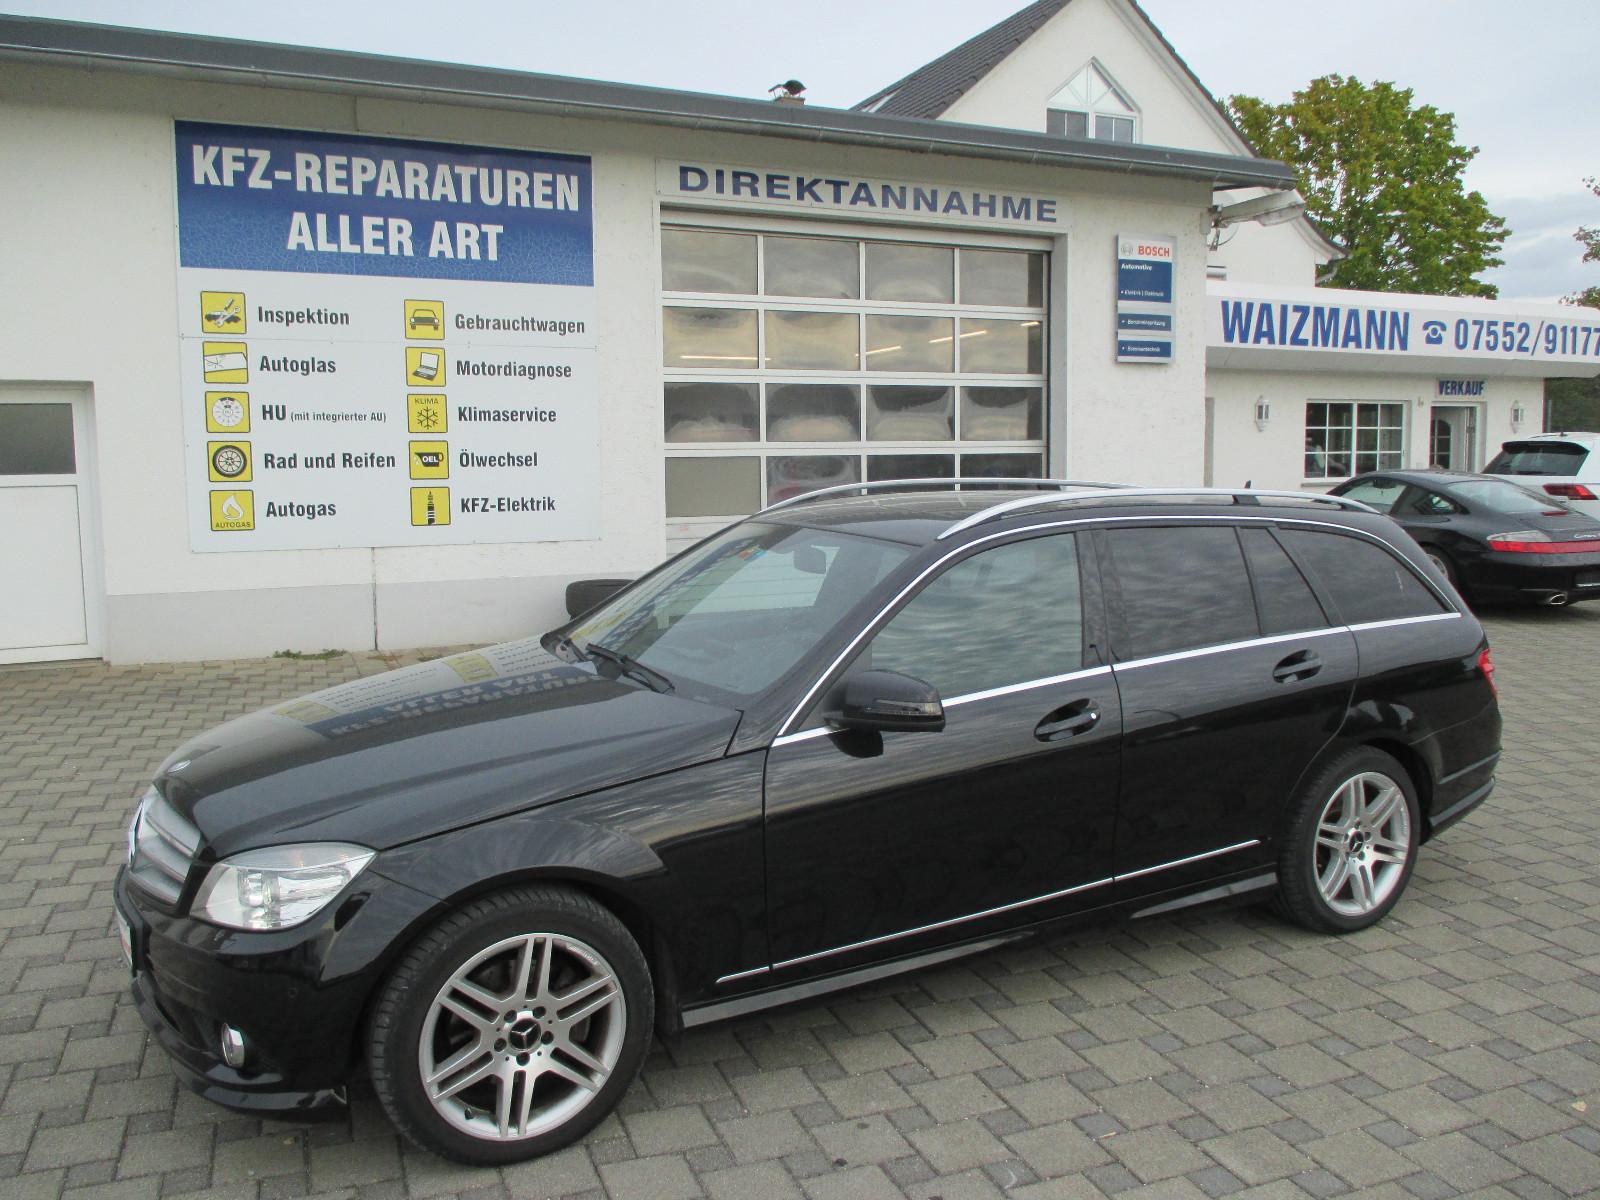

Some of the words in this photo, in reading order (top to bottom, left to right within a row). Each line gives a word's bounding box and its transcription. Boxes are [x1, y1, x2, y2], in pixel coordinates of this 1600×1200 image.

[192, 144, 580, 212] KFZ-REPARATUREN
[679, 165, 1058, 223] DIREKTANNAHME
[286, 211, 415, 257] ALLER
[428, 221, 504, 262] ART
[1138, 245, 1170, 257] BOSCH
[258, 306, 350, 326] Inspektion
[455, 313, 585, 336] Gebrauchtwagen
[1221, 300, 1410, 351] WAIZMANN
[260, 356, 337, 376] Autoglas
[456, 360, 572, 380] Motordiagnose
[1439, 380, 1485, 396] VERKAUF
[262, 404, 287, 421] HU
[290, 412, 309, 422] (mit
[313, 411, 368, 423] integrierter
[370, 411, 387, 423] AU)
[458, 406, 557, 422] Klimaservice
[264, 453, 298, 469] Rad
[304, 453, 336, 469] und
[342, 452, 396, 469] Reifen
[422, 455, 438, 463] OEL
[459, 449, 538, 468] Ölwechsel
[266, 502, 337, 519] Autogas
[461, 497, 556, 513] KFZ-Elektrik
[215, 521, 252, 529] AUTOGAS
